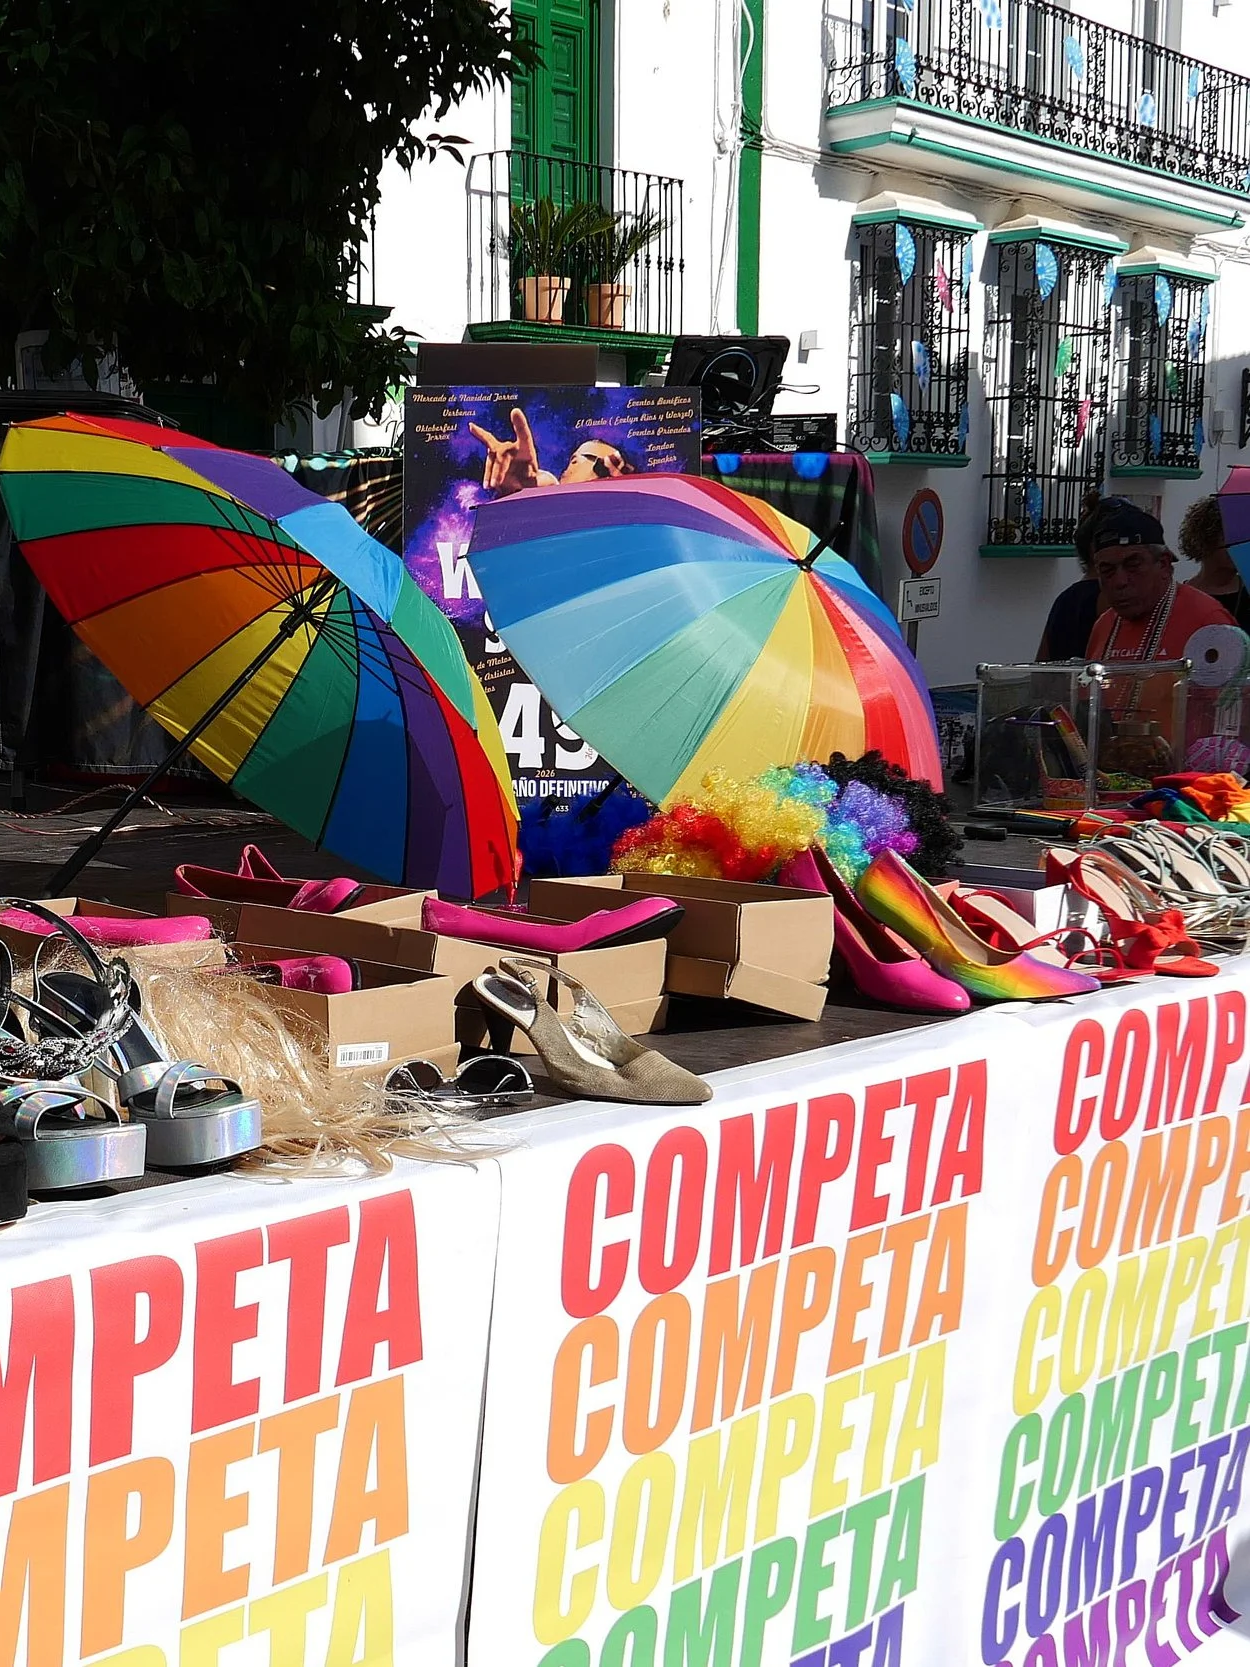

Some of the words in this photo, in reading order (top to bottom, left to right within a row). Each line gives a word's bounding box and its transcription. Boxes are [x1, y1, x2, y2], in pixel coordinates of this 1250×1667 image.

[412, 393, 447, 403] Mercado
[448, 393, 457, 402] de
[459, 393, 492, 402] Navidad
[493, 392, 518, 402] Torrox
[627, 396, 655, 408] Eventos
[442, 408, 476, 417] Verbenas
[415, 423, 458, 433] Oktoberfest
[575, 420, 583, 429] El
[425, 433, 451, 442] Torrox
[627, 428, 655, 439] Eventos
[657, 425, 692, 436] Privados
[646, 441, 675, 452] London
[647, 454, 677, 467] Speaker
[476, 661, 486, 670] de
[486, 656, 512, 667] Motos
[484, 668, 516, 681] Artistas
[534, 770, 556, 778] 2026
[1053, 990, 1250, 1156] COMP
[560, 1059, 988, 1319] COMPETA
[1031, 1115, 1250, 1288] COMPE
[1013, 1215, 1250, 1417] COMPET
[546, 1201, 969, 1485] COMPETA
[533, 1339, 947, 1645] COMPETA
[981, 1424, 1250, 1667] COMPETA
